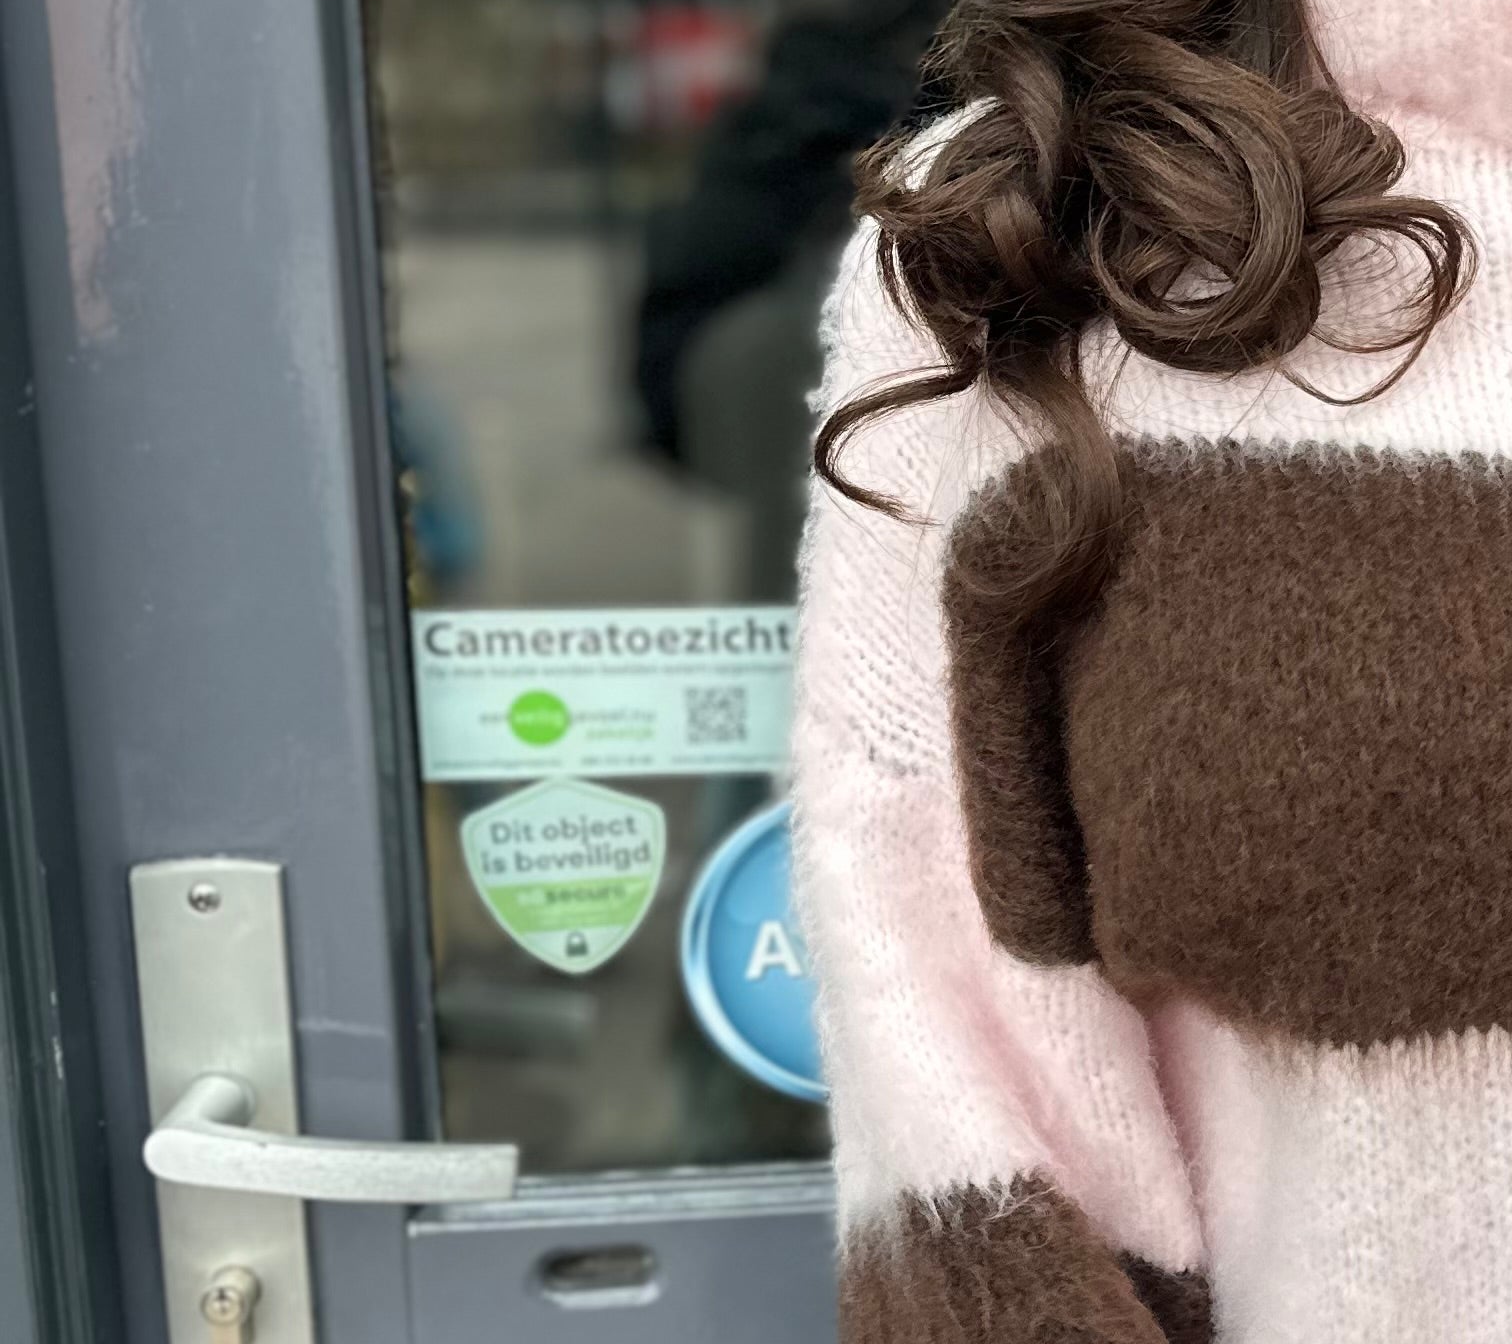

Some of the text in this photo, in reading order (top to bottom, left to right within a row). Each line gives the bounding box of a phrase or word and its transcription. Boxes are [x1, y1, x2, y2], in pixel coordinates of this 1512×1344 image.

[424, 618, 792, 658] Cameratoezicht
[489, 814, 637, 845] Dit object
[480, 840, 651, 875] is beveiligd
[744, 919, 803, 981] A
